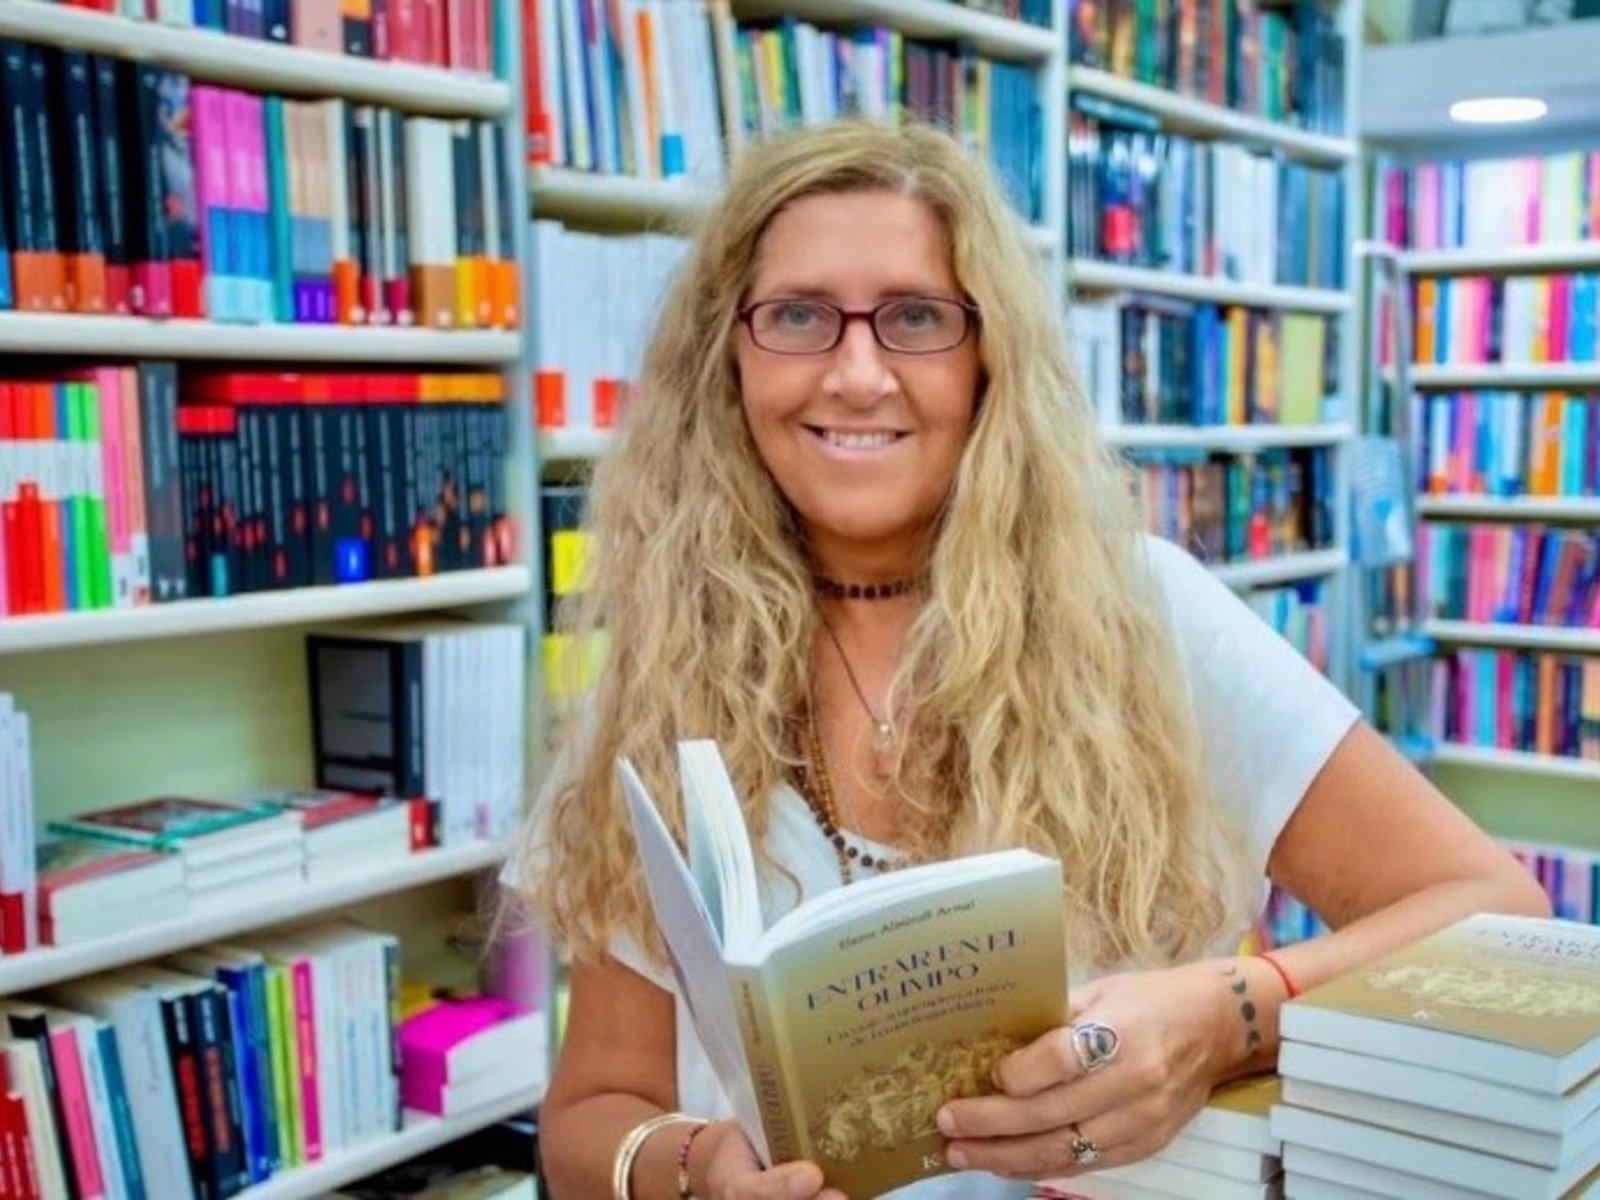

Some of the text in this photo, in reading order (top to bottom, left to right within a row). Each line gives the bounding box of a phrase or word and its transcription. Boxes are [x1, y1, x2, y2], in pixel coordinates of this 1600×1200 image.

[807, 928, 1024, 1012] ENTRAR EN EL
[857, 961, 980, 1012] OLIMPO
